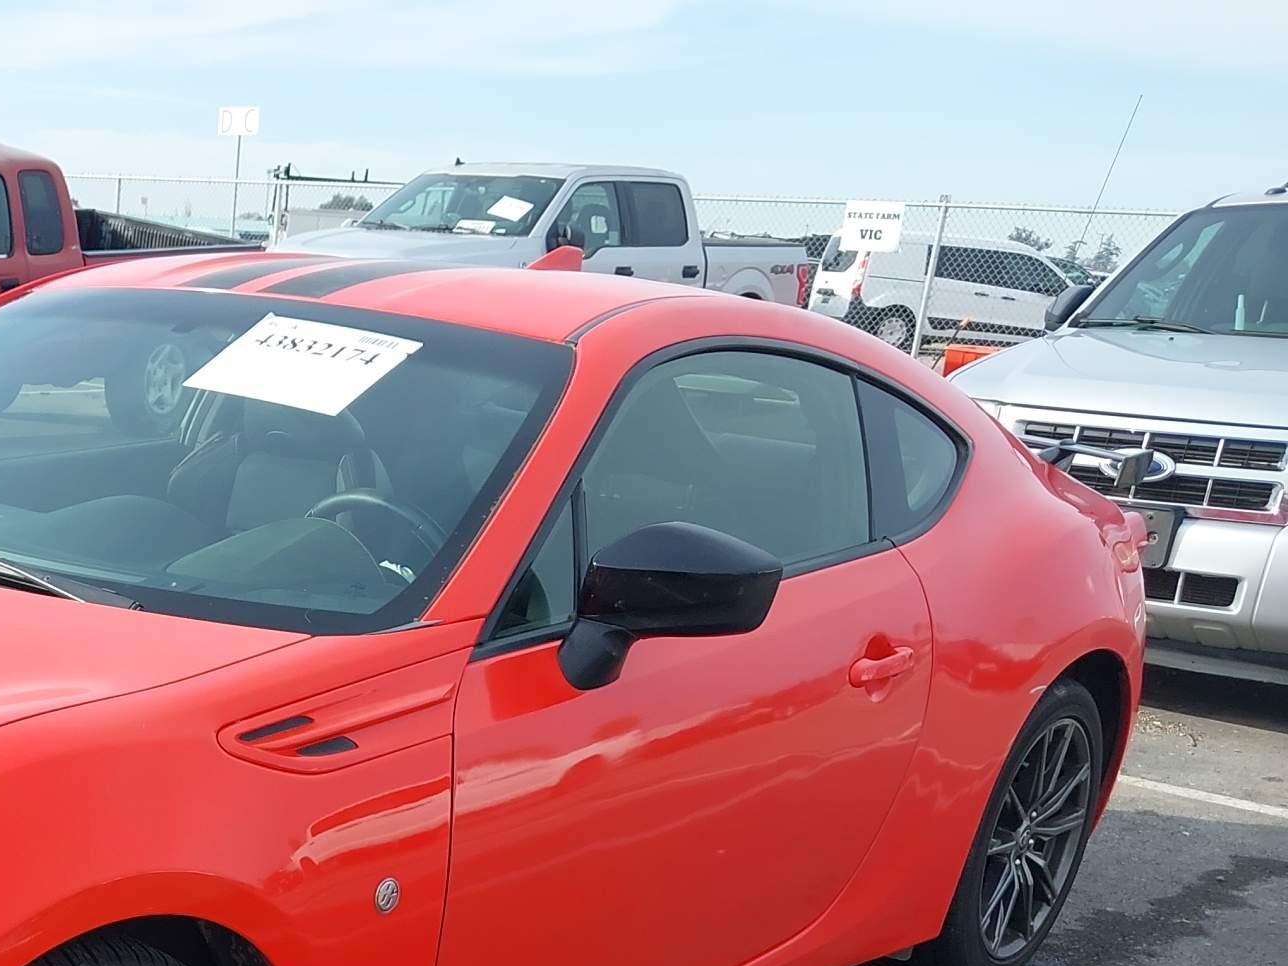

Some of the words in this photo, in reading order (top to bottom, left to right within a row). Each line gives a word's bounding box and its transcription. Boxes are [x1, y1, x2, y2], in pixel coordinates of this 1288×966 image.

[847, 211, 874, 220] STATE
[876, 212, 901, 221] FARM
[859, 228, 883, 241] VIC
[255, 333, 381, 365] 43832174
